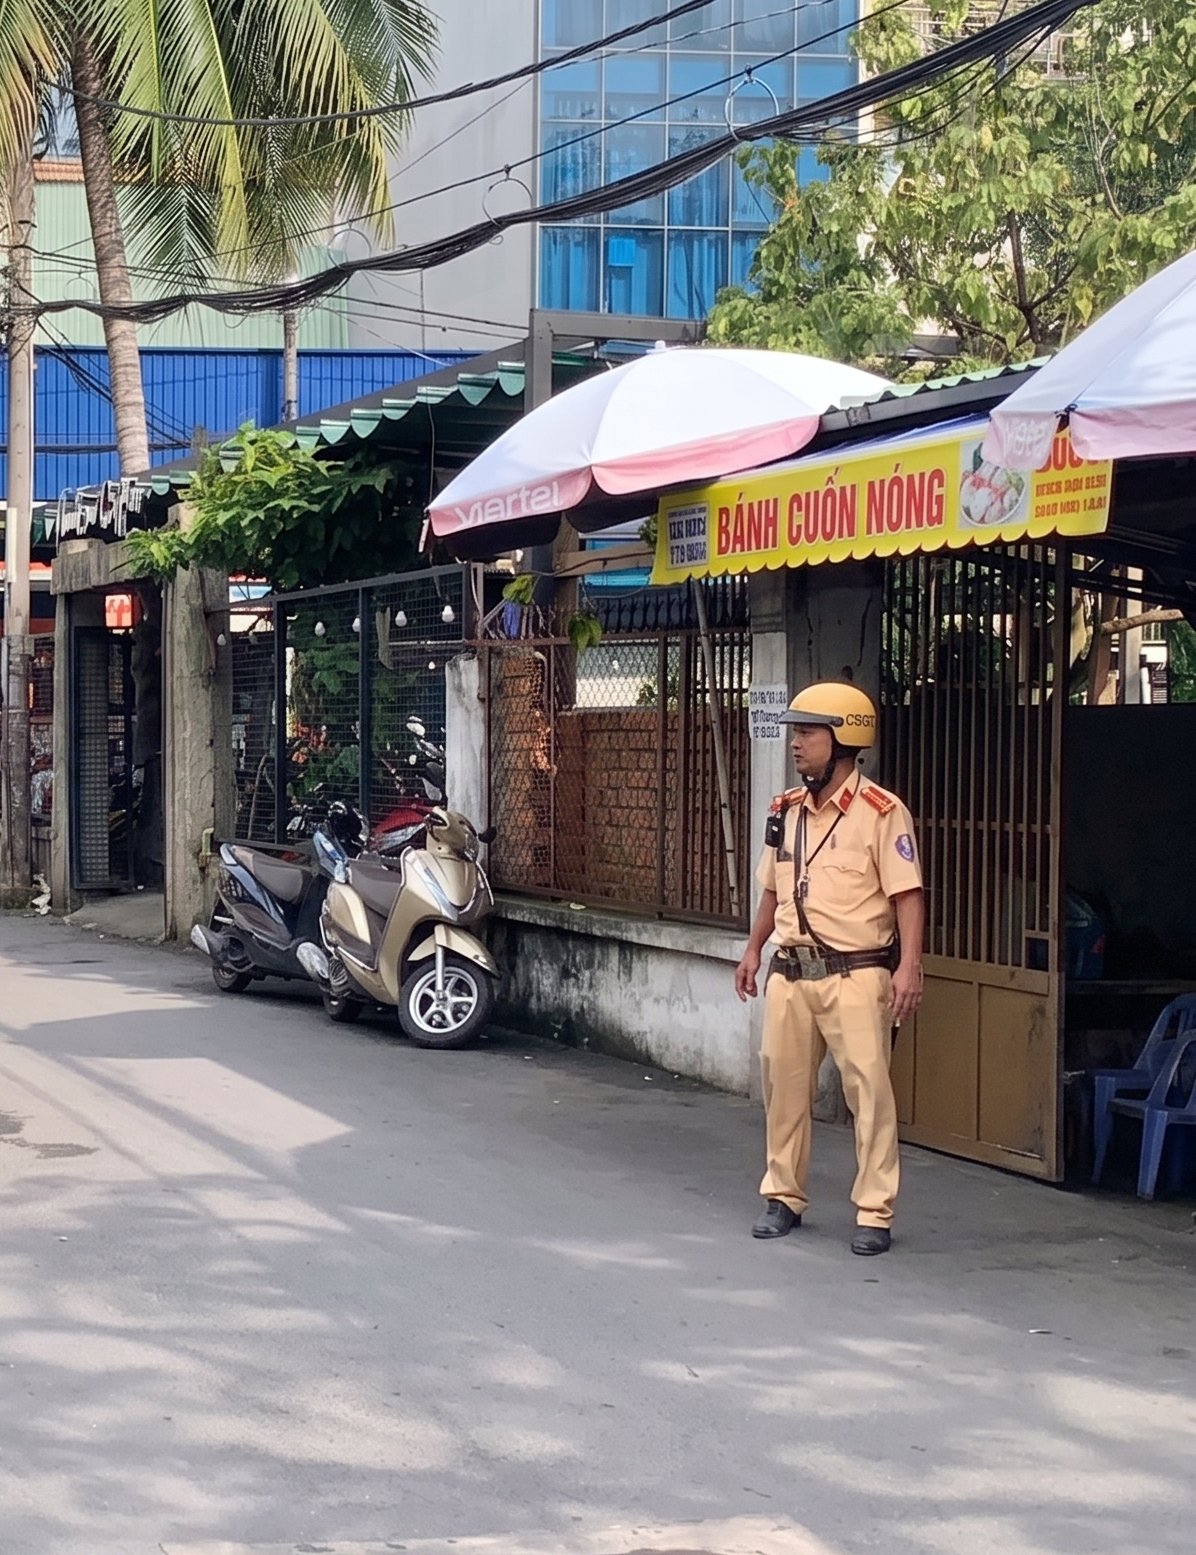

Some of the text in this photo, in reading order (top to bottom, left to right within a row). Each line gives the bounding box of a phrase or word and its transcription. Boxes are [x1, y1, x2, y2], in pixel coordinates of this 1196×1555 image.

[717, 463, 945, 556] BÁNH CUỐN NÓNG
[846, 713, 876, 728] CSGT
